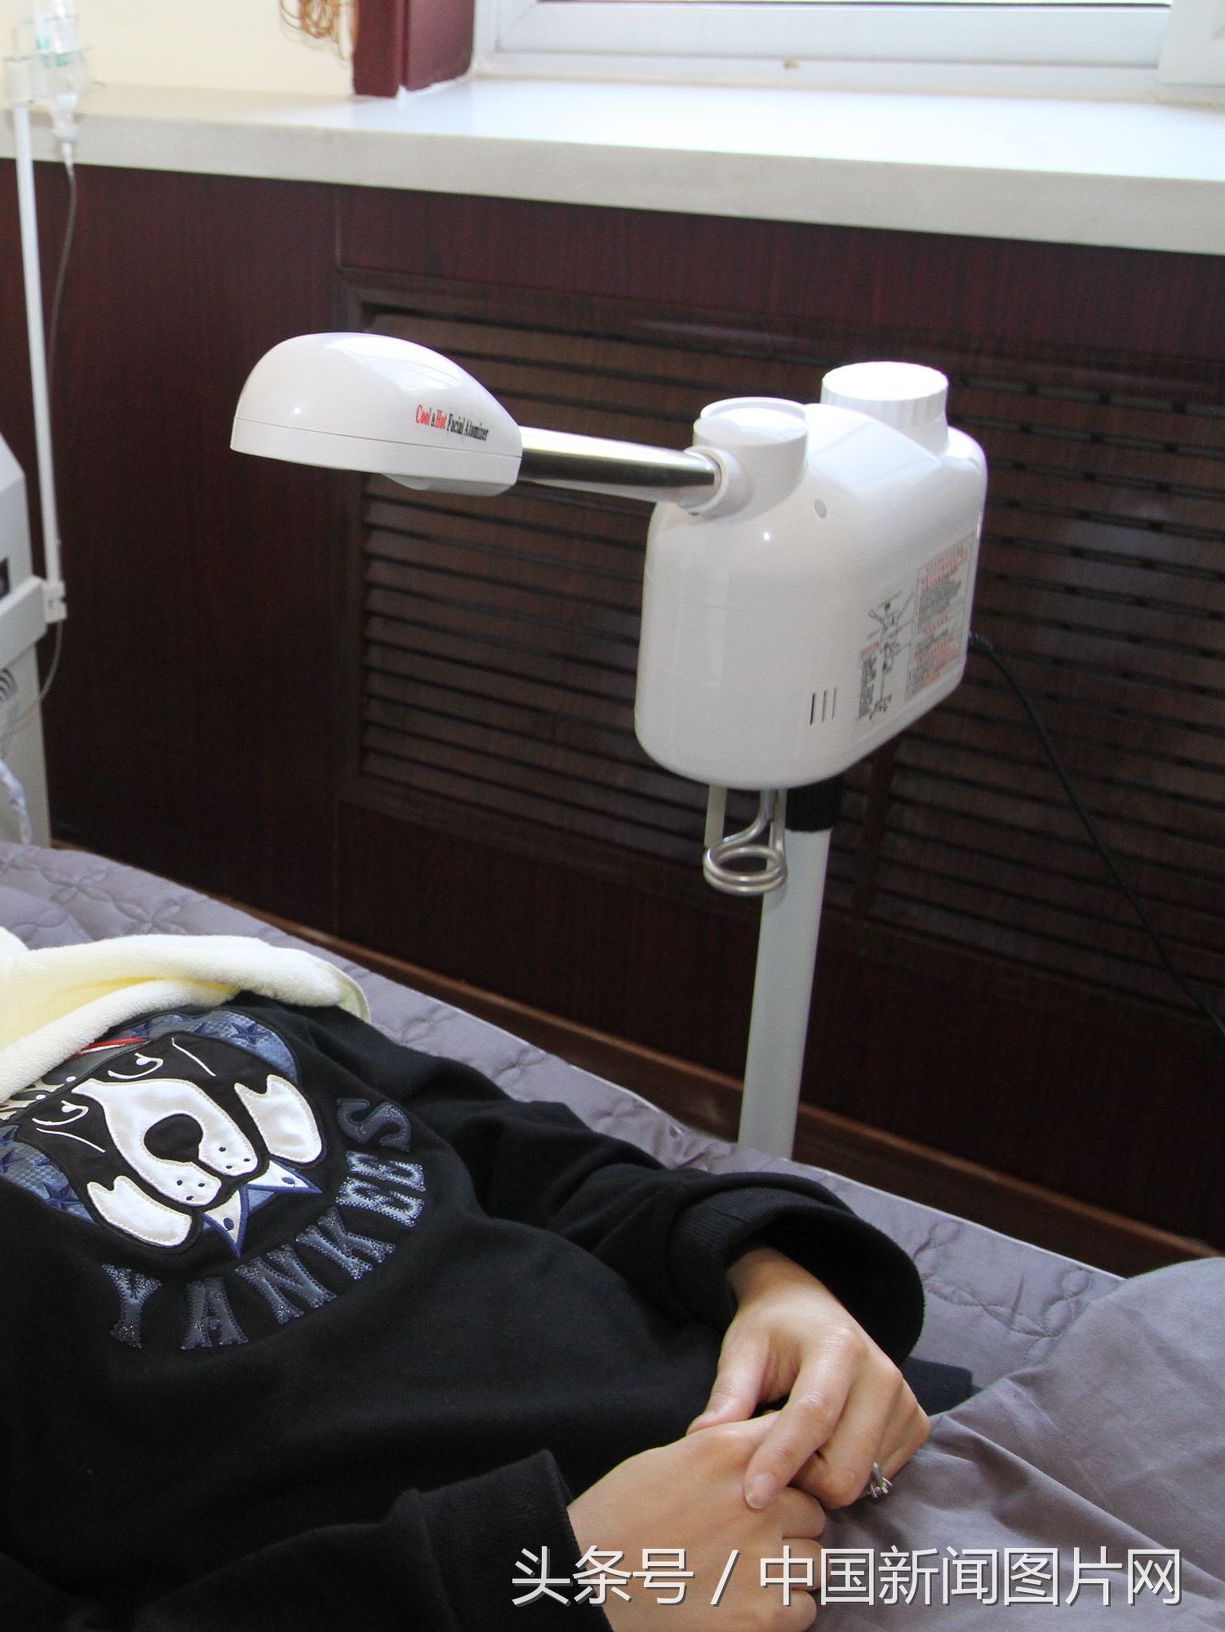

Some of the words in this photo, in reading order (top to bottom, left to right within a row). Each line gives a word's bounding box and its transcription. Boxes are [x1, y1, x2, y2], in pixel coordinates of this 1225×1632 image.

[416, 404, 431, 425] Cool
[436, 409, 446, 428] Hot
[447, 413, 466, 434] Facial
[101, 1098, 425, 1350] YANKEES
